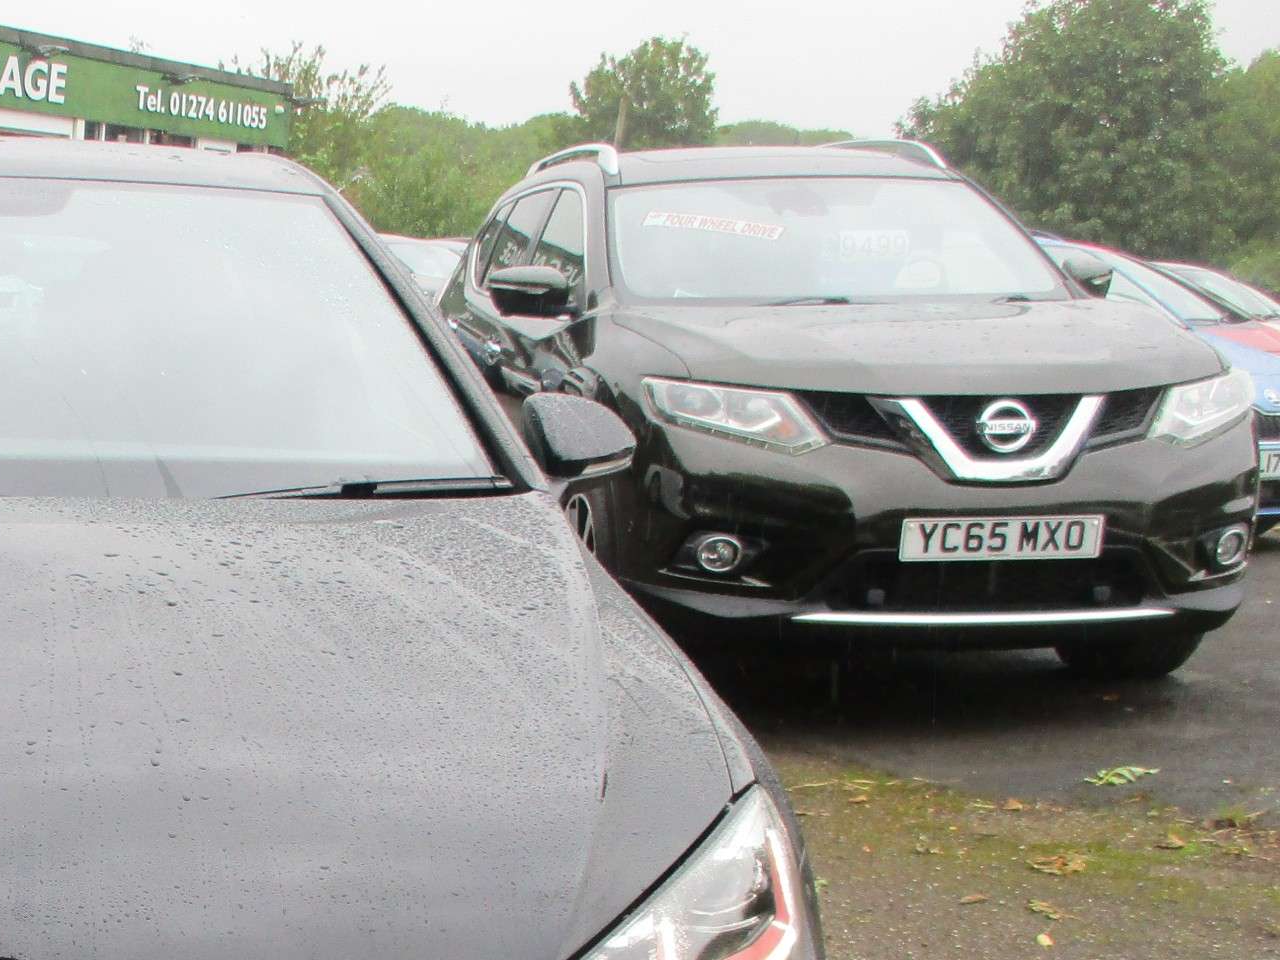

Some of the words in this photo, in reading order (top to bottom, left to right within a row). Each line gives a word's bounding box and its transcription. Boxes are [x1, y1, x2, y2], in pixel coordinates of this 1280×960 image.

[136, 85, 165, 113] Tel.
[170, 92, 214, 120] 01274
[218, 100, 267, 129] 611055
[664, 212, 696, 227] FOUR
[699, 215, 737, 232] WHEEL
[741, 222, 778, 238] DRIVE
[982, 422, 1034, 433] NISSAN
[919, 522, 1009, 554] YC65
[1017, 520, 1086, 552] MXO
